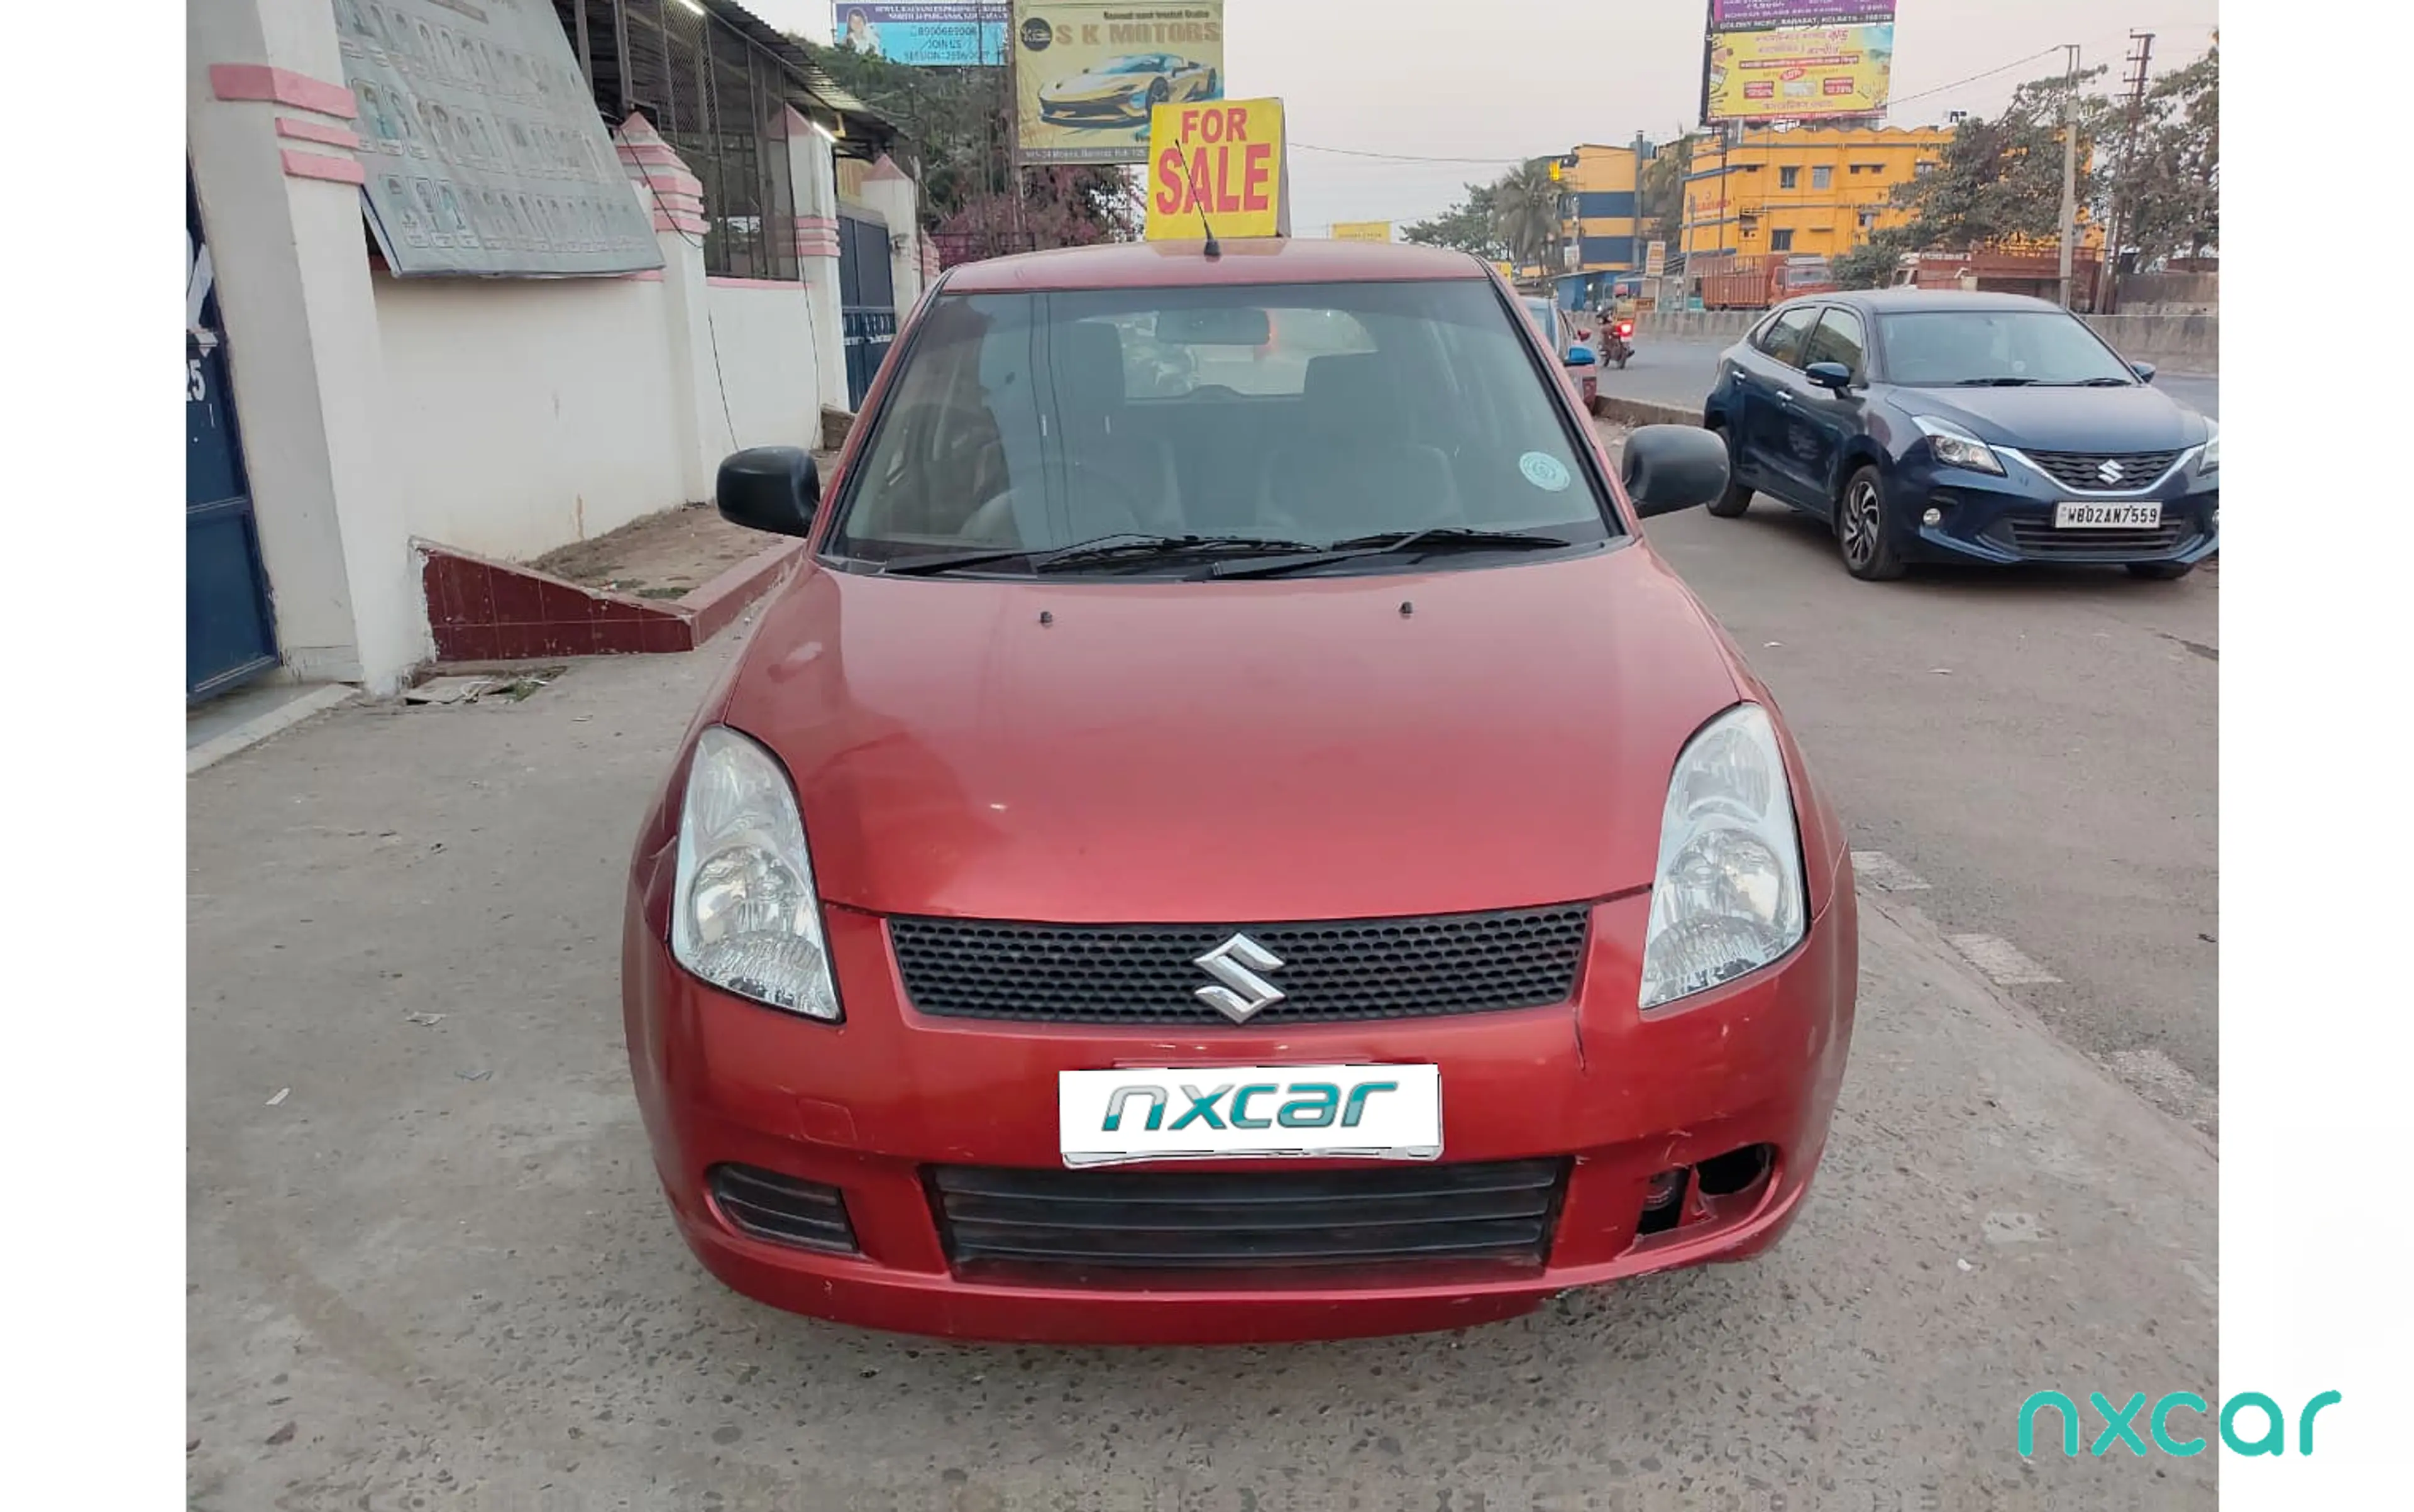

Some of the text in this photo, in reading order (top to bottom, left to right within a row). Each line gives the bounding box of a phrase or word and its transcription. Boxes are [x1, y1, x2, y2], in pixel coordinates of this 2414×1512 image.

[1055, 25, 1073, 45] S
[1081, 24, 1100, 45] K
[1109, 22, 1221, 44] MOTORS
[1181, 108, 1247, 143] FOR
[1156, 143, 1270, 215] SALE
[2068, 507, 2157, 524] WB02AN7559
